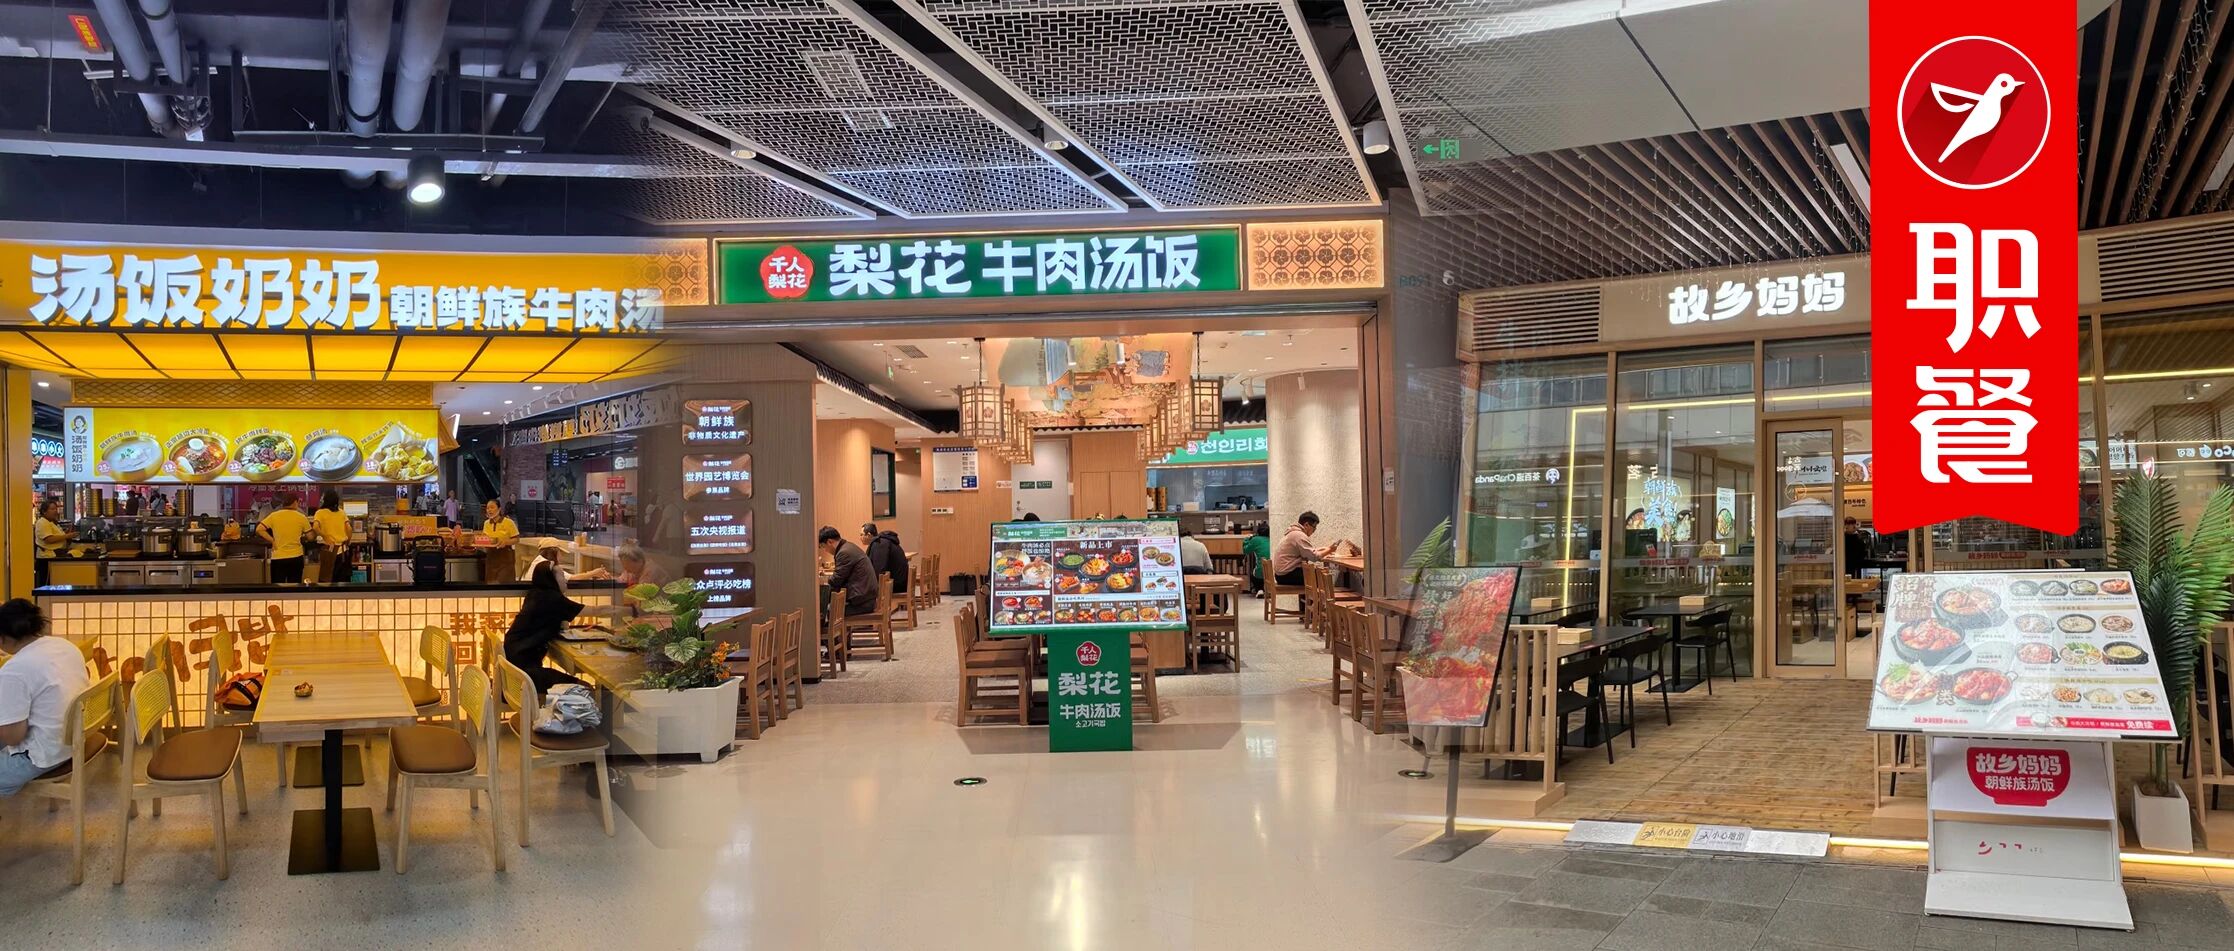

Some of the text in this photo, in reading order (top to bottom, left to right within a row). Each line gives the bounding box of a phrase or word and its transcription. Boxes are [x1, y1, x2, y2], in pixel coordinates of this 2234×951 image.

[769, 256, 804, 273] 千人
[829, 235, 1201, 296] 梨花 牛肉汤饭
[768, 273, 807, 288] 梨花
[29, 254, 381, 328] 汤饭奶奶
[1668, 271, 1845, 325] 故乡妈妈
[390, 285, 664, 330] 朝鲜族牛肉汤
[698, 415, 735, 427] 朝鲜族
[688, 431, 745, 440] 非物质文化遗产
[685, 471, 749, 481] 世界园艺博览会
[690, 525, 746, 536] 五次央视报道
[1080, 541, 1113, 549] 新品上市
[693, 579, 752, 590] 众点评必吃榜
[1080, 646, 1097, 654] 千人
[1058, 671, 1121, 695] 梨花
[1060, 702, 1121, 719] 牛肉汤饭
[1975, 753, 2062, 776] 故乡妈妈
[1985, 775, 2055, 792] 朝鲜族汤饭
